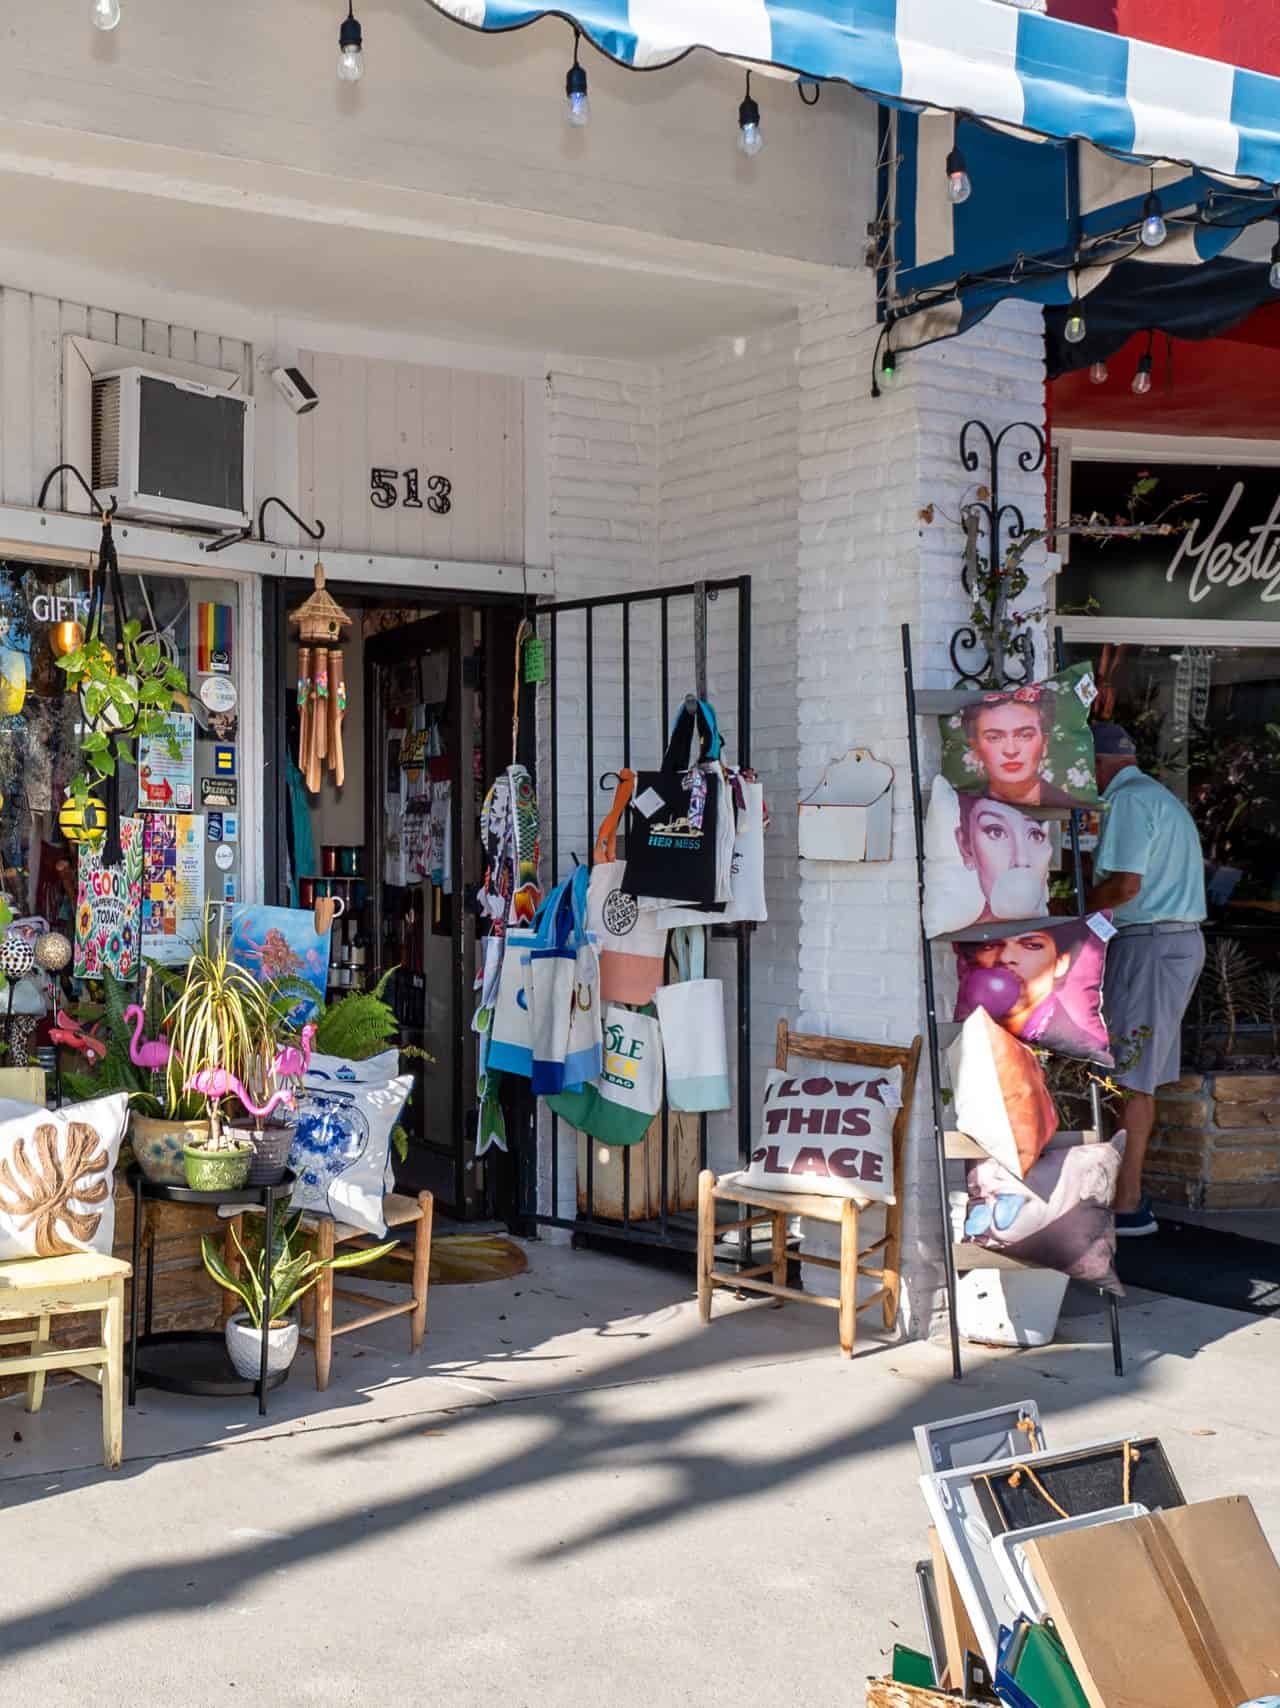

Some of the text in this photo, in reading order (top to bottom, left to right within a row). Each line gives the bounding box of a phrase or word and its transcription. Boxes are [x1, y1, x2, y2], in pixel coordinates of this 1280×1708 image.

[371, 468, 452, 514] 513
[648, 836, 701, 850] HER MESS
[93, 872, 127, 901] GOOD
[97, 909, 119, 926] TODAY
[606, 1025, 645, 1060] OLE
[766, 1107, 872, 1136] THIS
[748, 1145, 884, 1183] PLACE
